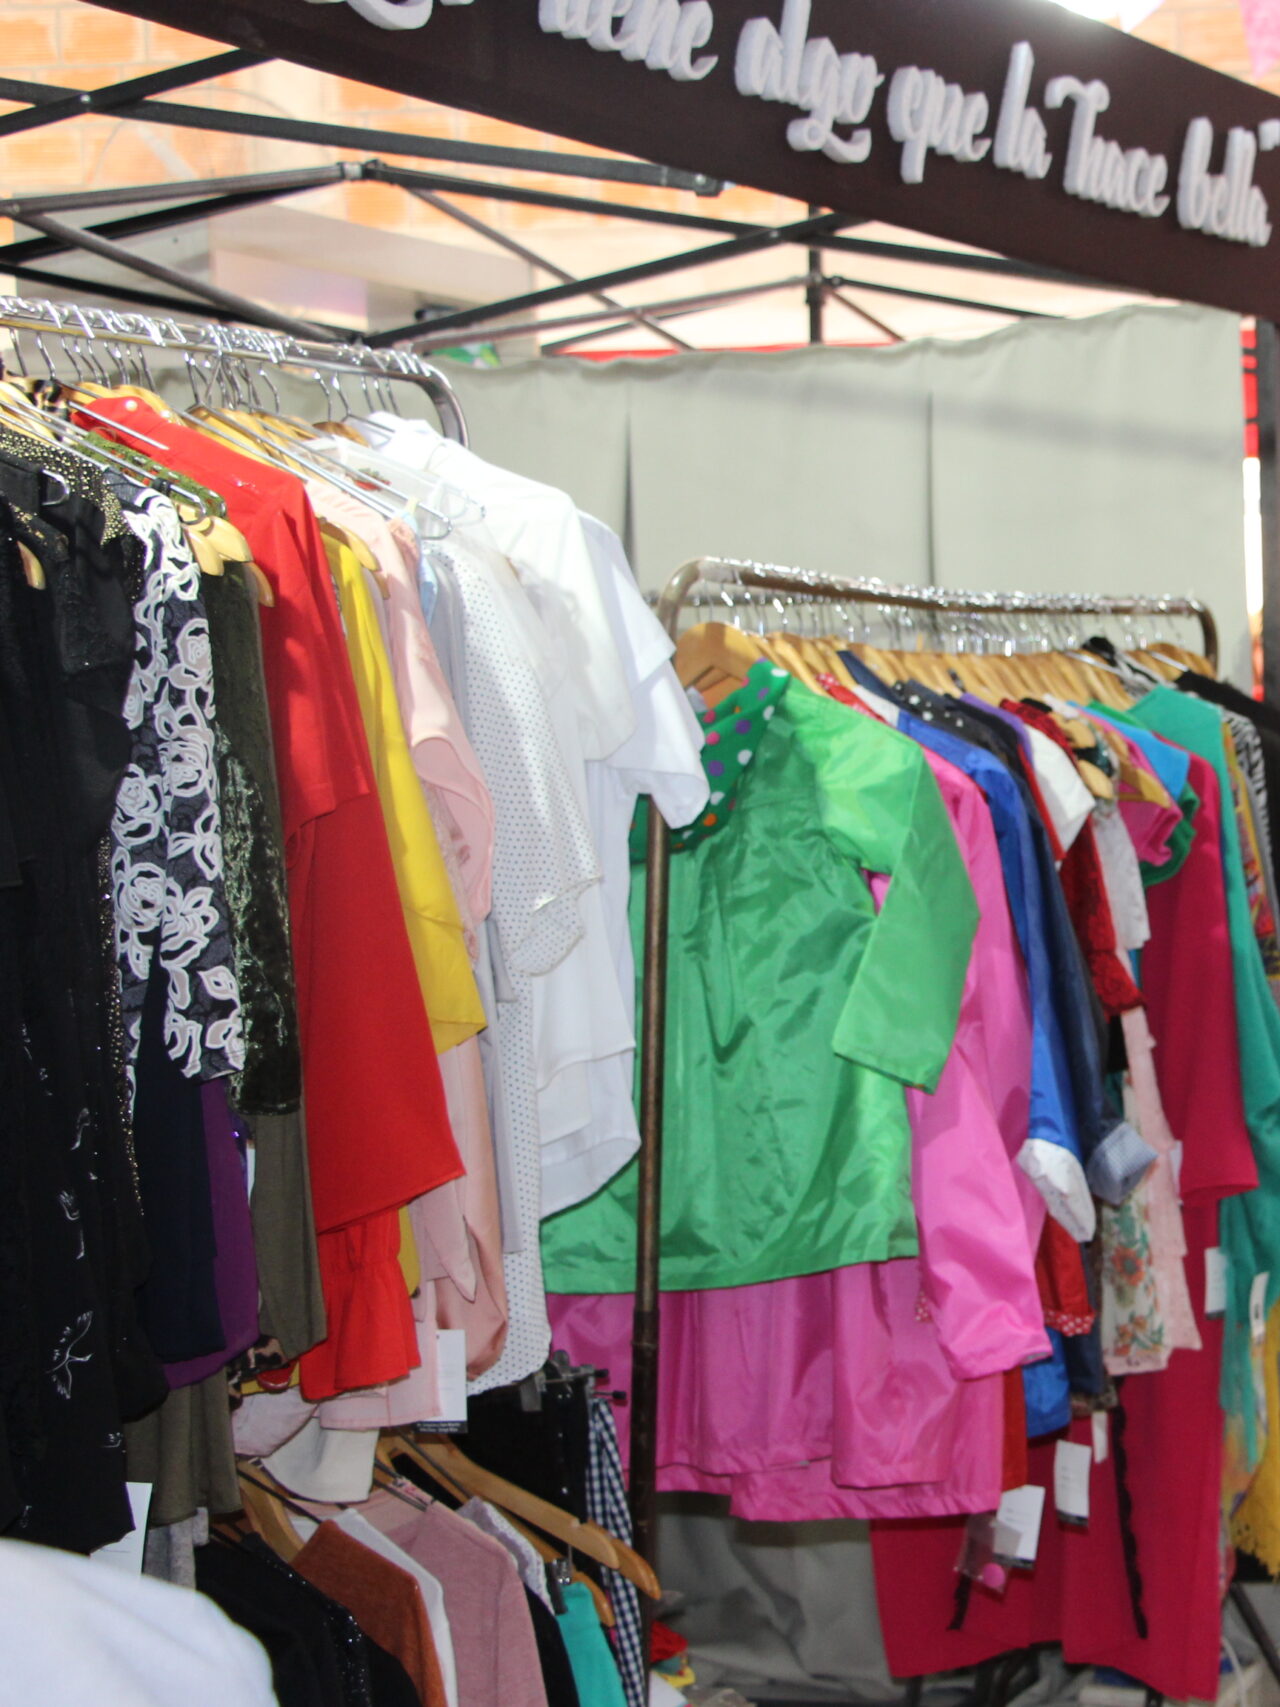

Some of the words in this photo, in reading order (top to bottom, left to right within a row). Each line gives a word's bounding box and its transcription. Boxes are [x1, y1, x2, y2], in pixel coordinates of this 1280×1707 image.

[734, 0, 885, 163] algo
[887, 65, 992, 184] que
[993, 40, 1052, 179] la
